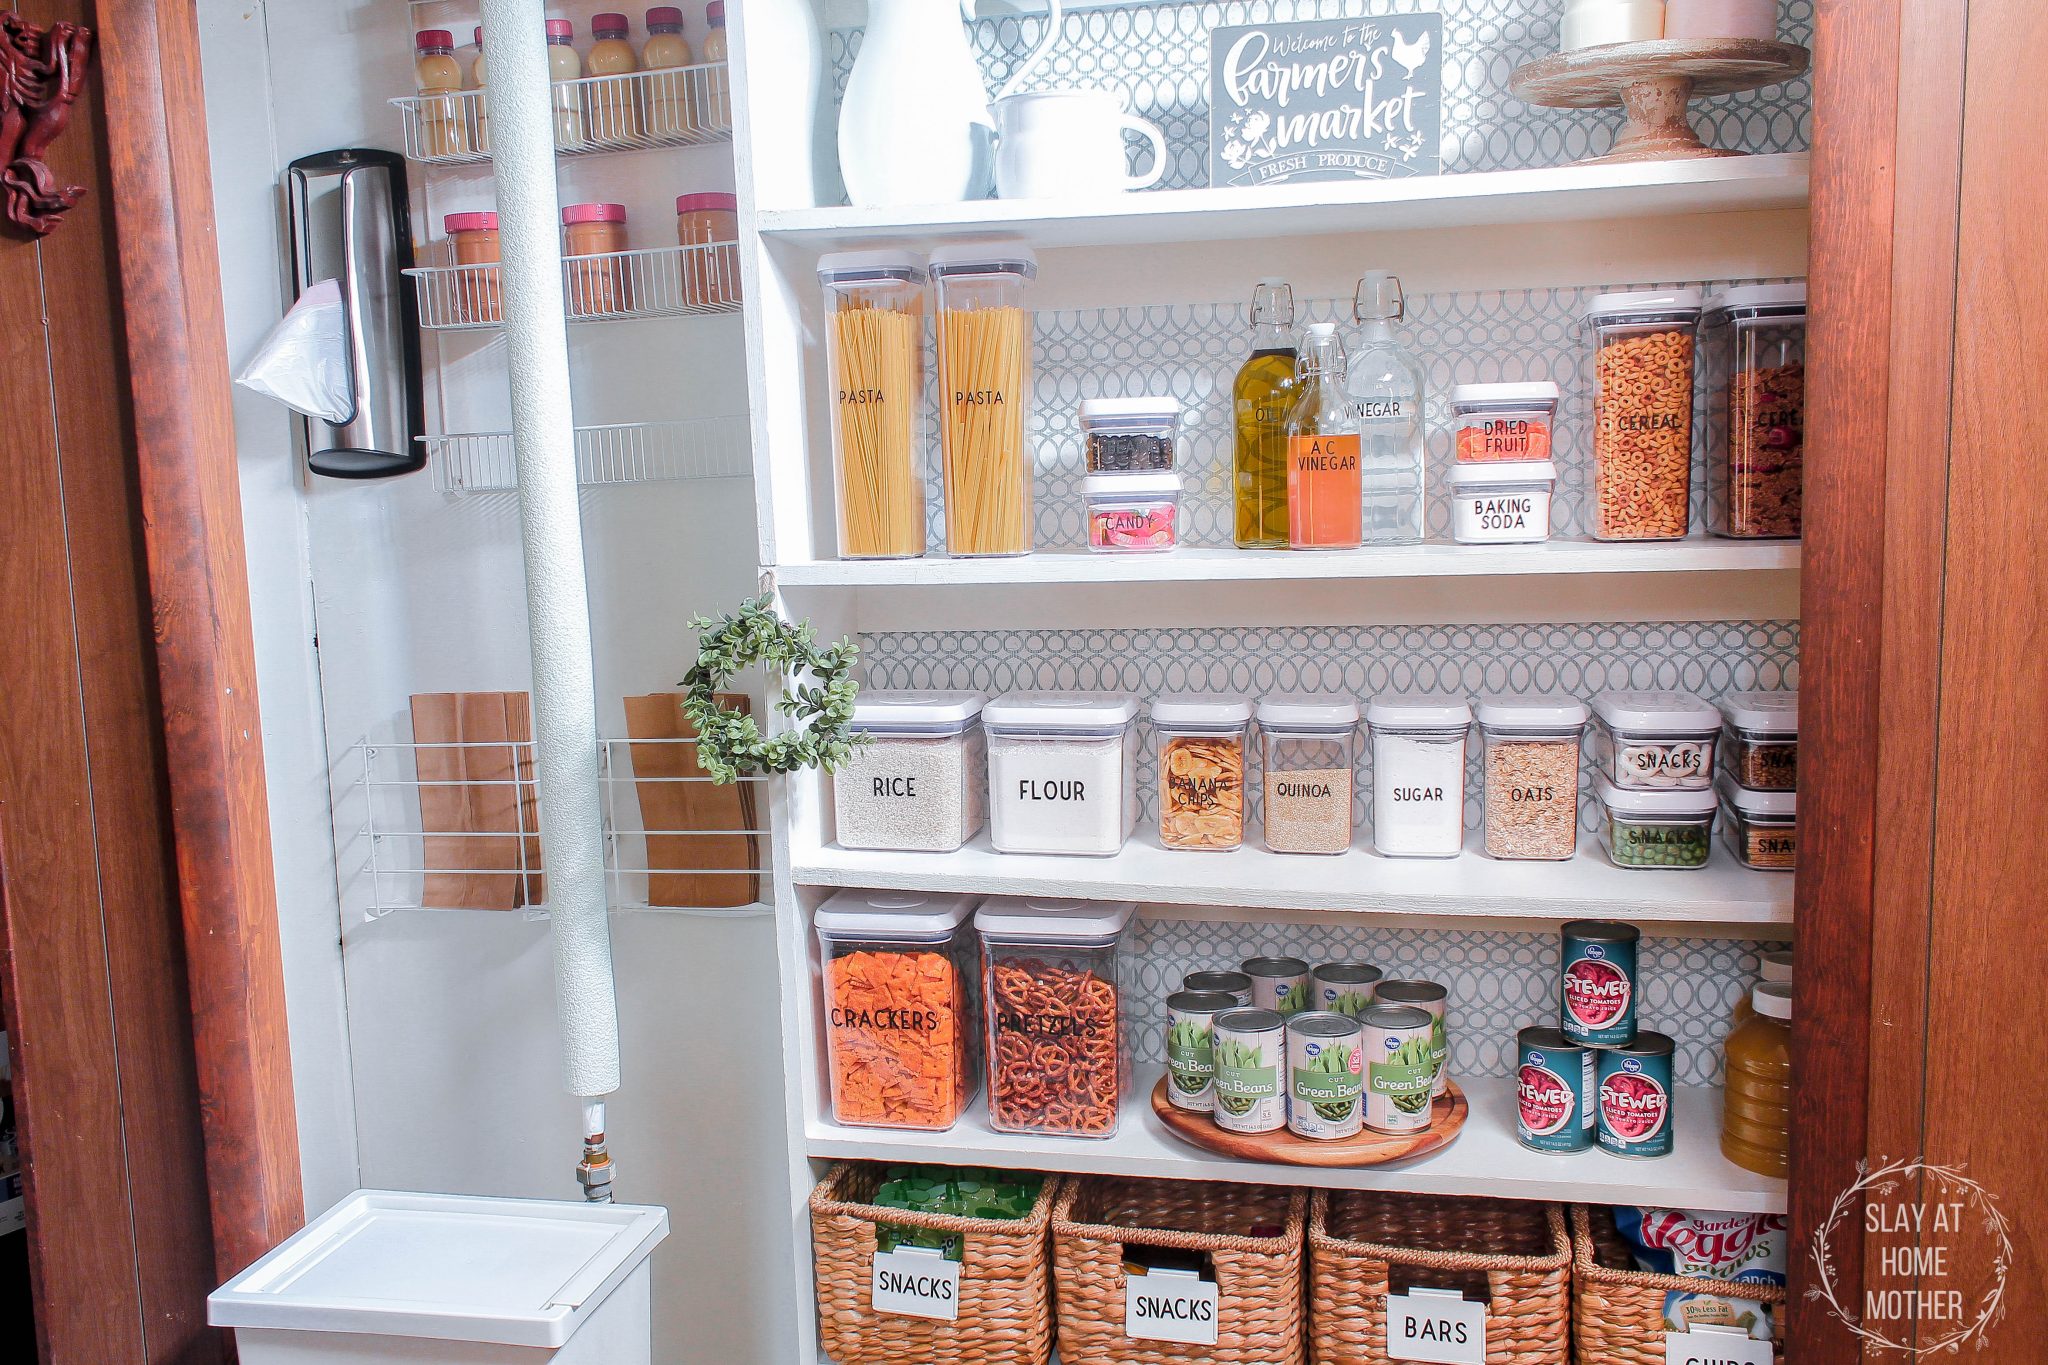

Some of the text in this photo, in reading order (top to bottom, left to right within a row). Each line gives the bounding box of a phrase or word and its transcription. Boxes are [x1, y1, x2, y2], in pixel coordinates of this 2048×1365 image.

[1273, 23, 1382, 57] Welcome to the
[1276, 79, 1426, 148] market
[1259, 153, 1389, 180] FRESH PRODUCE
[839, 389, 885, 405] PASTA
[955, 390, 1005, 406] PASTA
[1618, 413, 1682, 431] CEREAL
[1758, 408, 1803, 427] CERE
[1484, 419, 1528, 436] DRIED
[1485, 436, 1526, 453] FRUIT
[1298, 455, 1356, 471] VINEGAR
[1474, 498, 1531, 515] BAKING
[1105, 515, 1154, 530] CANDY
[1481, 514, 1525, 530] SODA
[1637, 752, 1701, 769] SNACKS
[873, 776, 917, 798] RICE
[1019, 779, 1086, 802] FLOUR
[1169, 776, 1228, 791] BANANA
[1277, 782, 1332, 799] QUINOA
[1178, 792, 1215, 807] CHIPS
[1393, 787, 1444, 802] SUGAR
[1511, 786, 1553, 802] OATS
[1758, 838, 1796, 853] SNA
[1564, 973, 1631, 997] STEWED
[831, 1007, 938, 1031] CRACKERS
[998, 1012, 1096, 1037] PRETZELS
[1181, 1050, 1195, 1058] CUT
[1168, 1057, 1214, 1072] reen Bea
[1408, 1067, 1421, 1075] CUT
[1226, 1070, 1240, 1078] CUT
[1374, 1075, 1414, 1091] Green
[1416, 1073, 1432, 1090] Bea
[1214, 1077, 1273, 1094] reen Beans
[1296, 1082, 1335, 1098] Green
[1600, 1085, 1667, 1110] STEWED
[879, 1271, 952, 1300] SNACKS
[1736, 1274, 1776, 1285] anch
[1136, 1296, 1212, 1322] SNACKS
[1405, 1316, 1468, 1344] BARS
